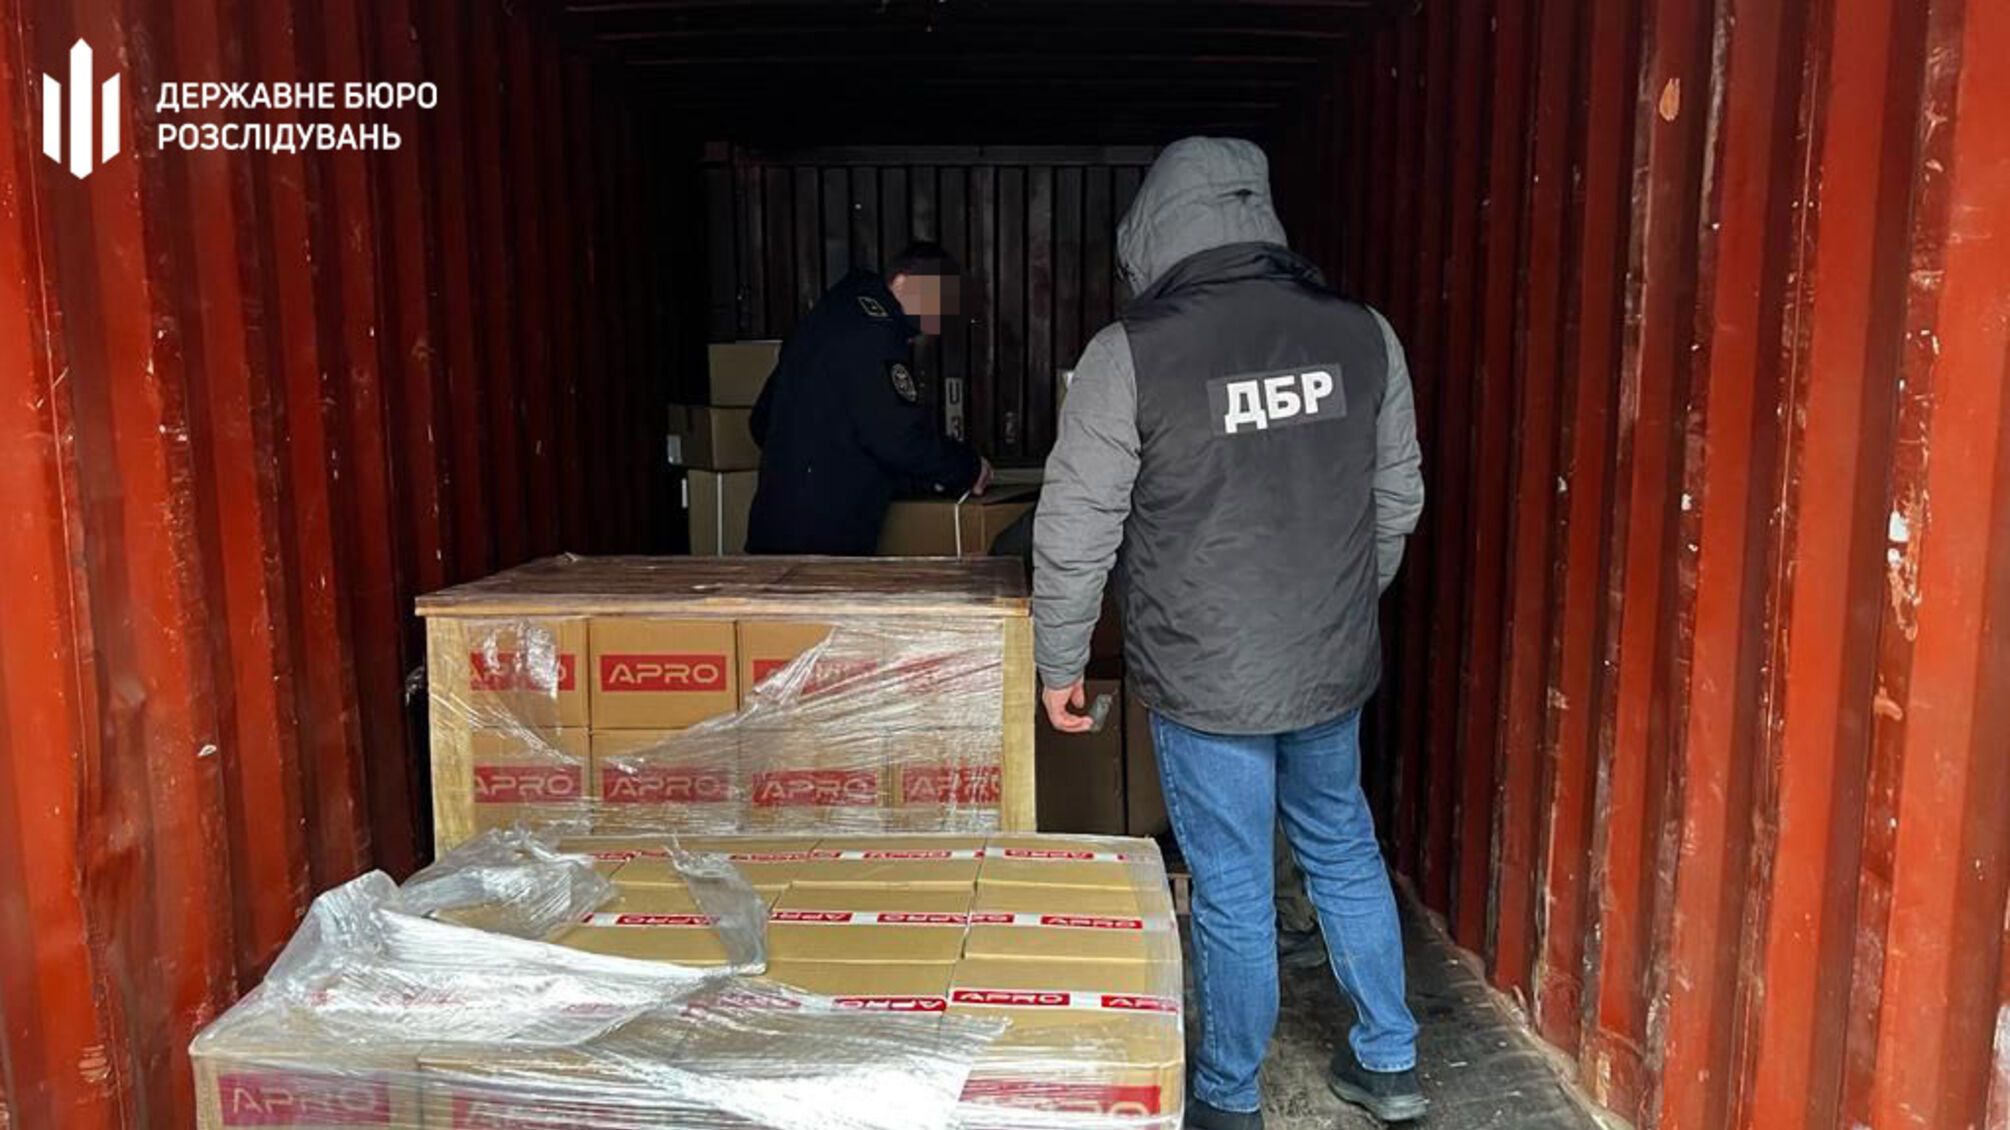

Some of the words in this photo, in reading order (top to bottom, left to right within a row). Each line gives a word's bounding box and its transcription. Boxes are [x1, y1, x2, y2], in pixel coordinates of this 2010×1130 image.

[1224, 371, 1333, 434] ДБР
[608, 663, 720, 685] APRO
[606, 777, 721, 797] APRO
[1047, 916, 1138, 928] APRO
[960, 991, 1063, 1003] APRO
